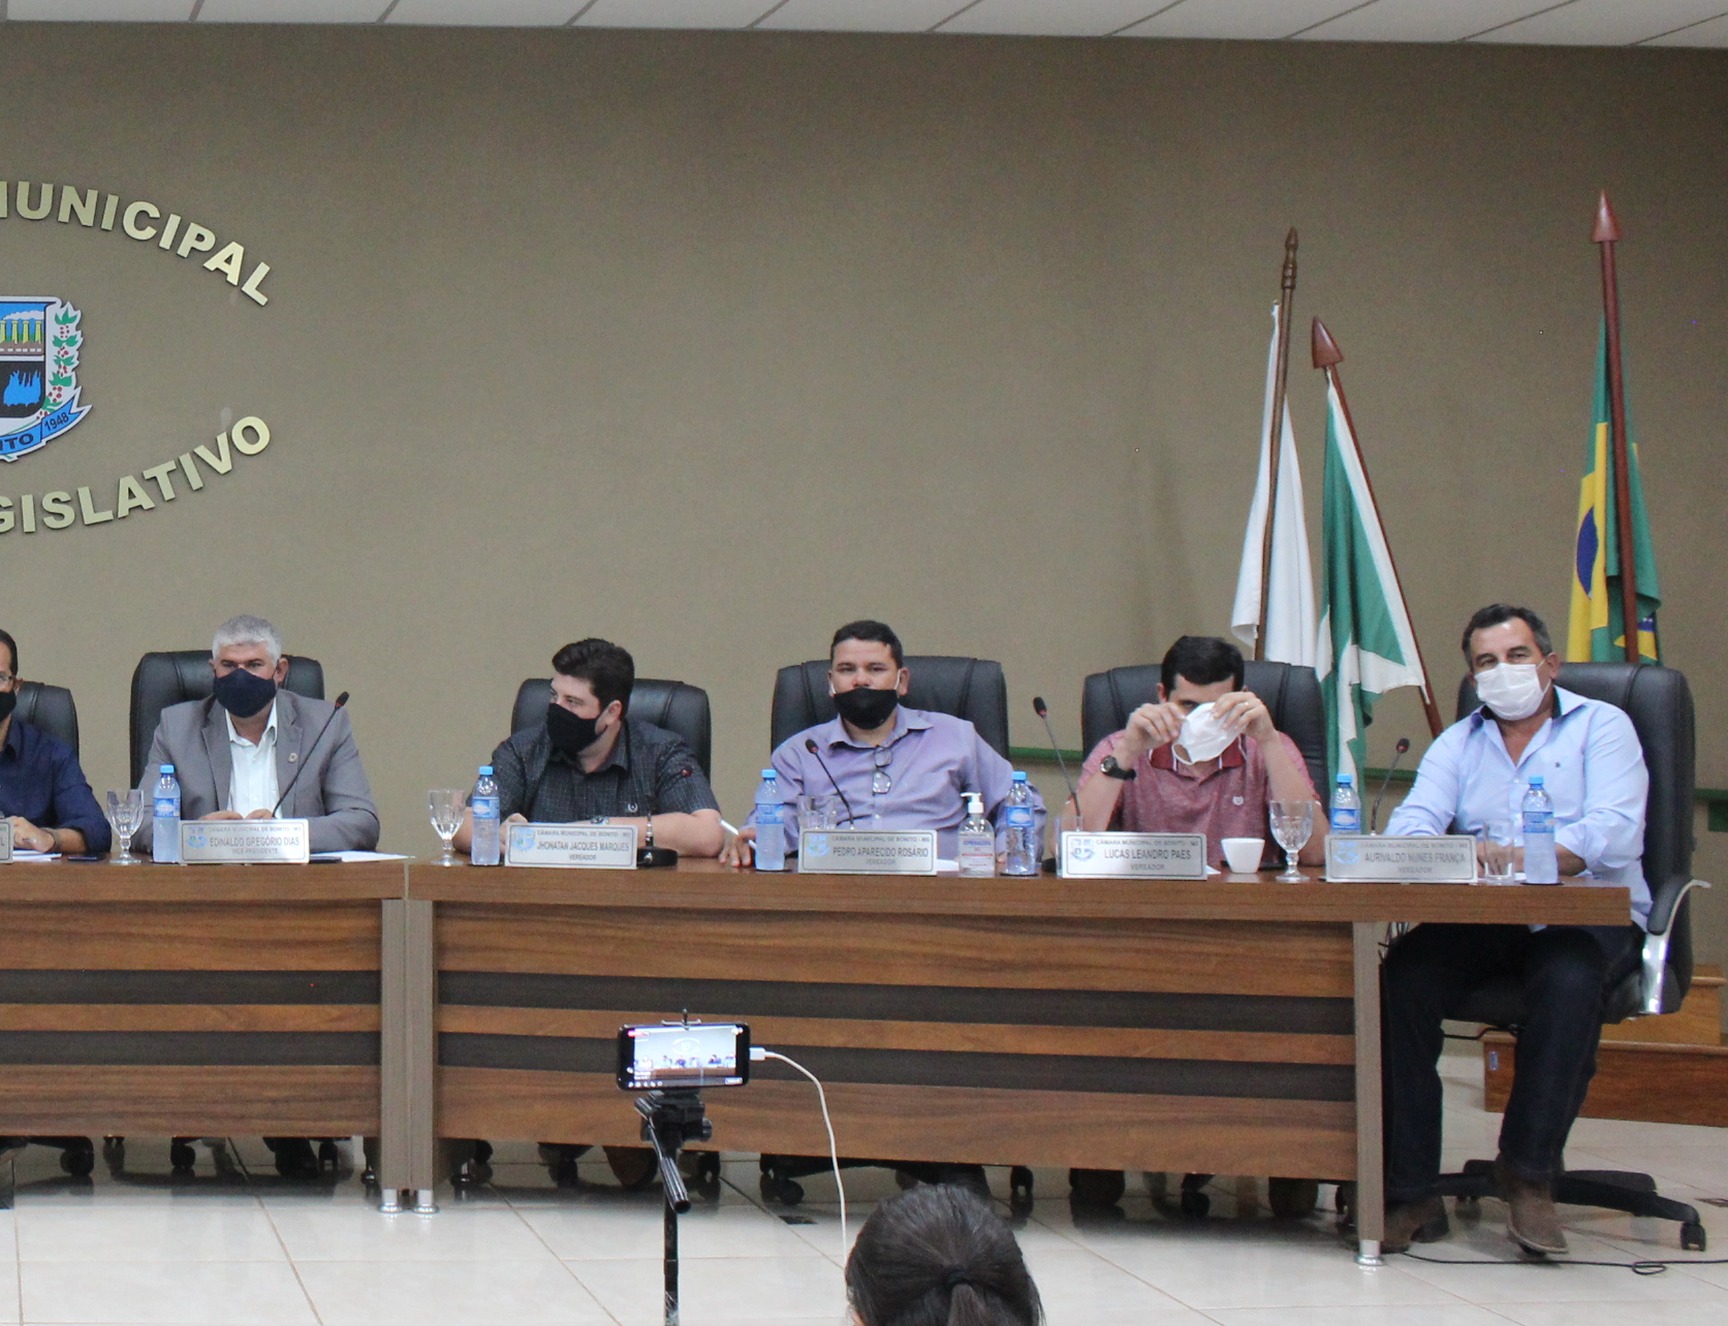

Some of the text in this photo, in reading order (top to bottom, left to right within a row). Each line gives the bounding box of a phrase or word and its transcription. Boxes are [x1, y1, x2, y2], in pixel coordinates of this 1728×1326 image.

[44, 413, 69, 431] 1948
[210, 836, 299, 847] EDINALDO GREGÓRIO DIAS
[537, 841, 629, 851] JHONATAN JACQUES MARQUES
[833, 847, 856, 856] PEDRO
[858, 847, 897, 856] APARECIDO
[1104, 849, 1191, 859] LUCAS LEANDRO PAES
[1365, 853, 1465, 864] AURIVALDO NUNES FRANÇA
